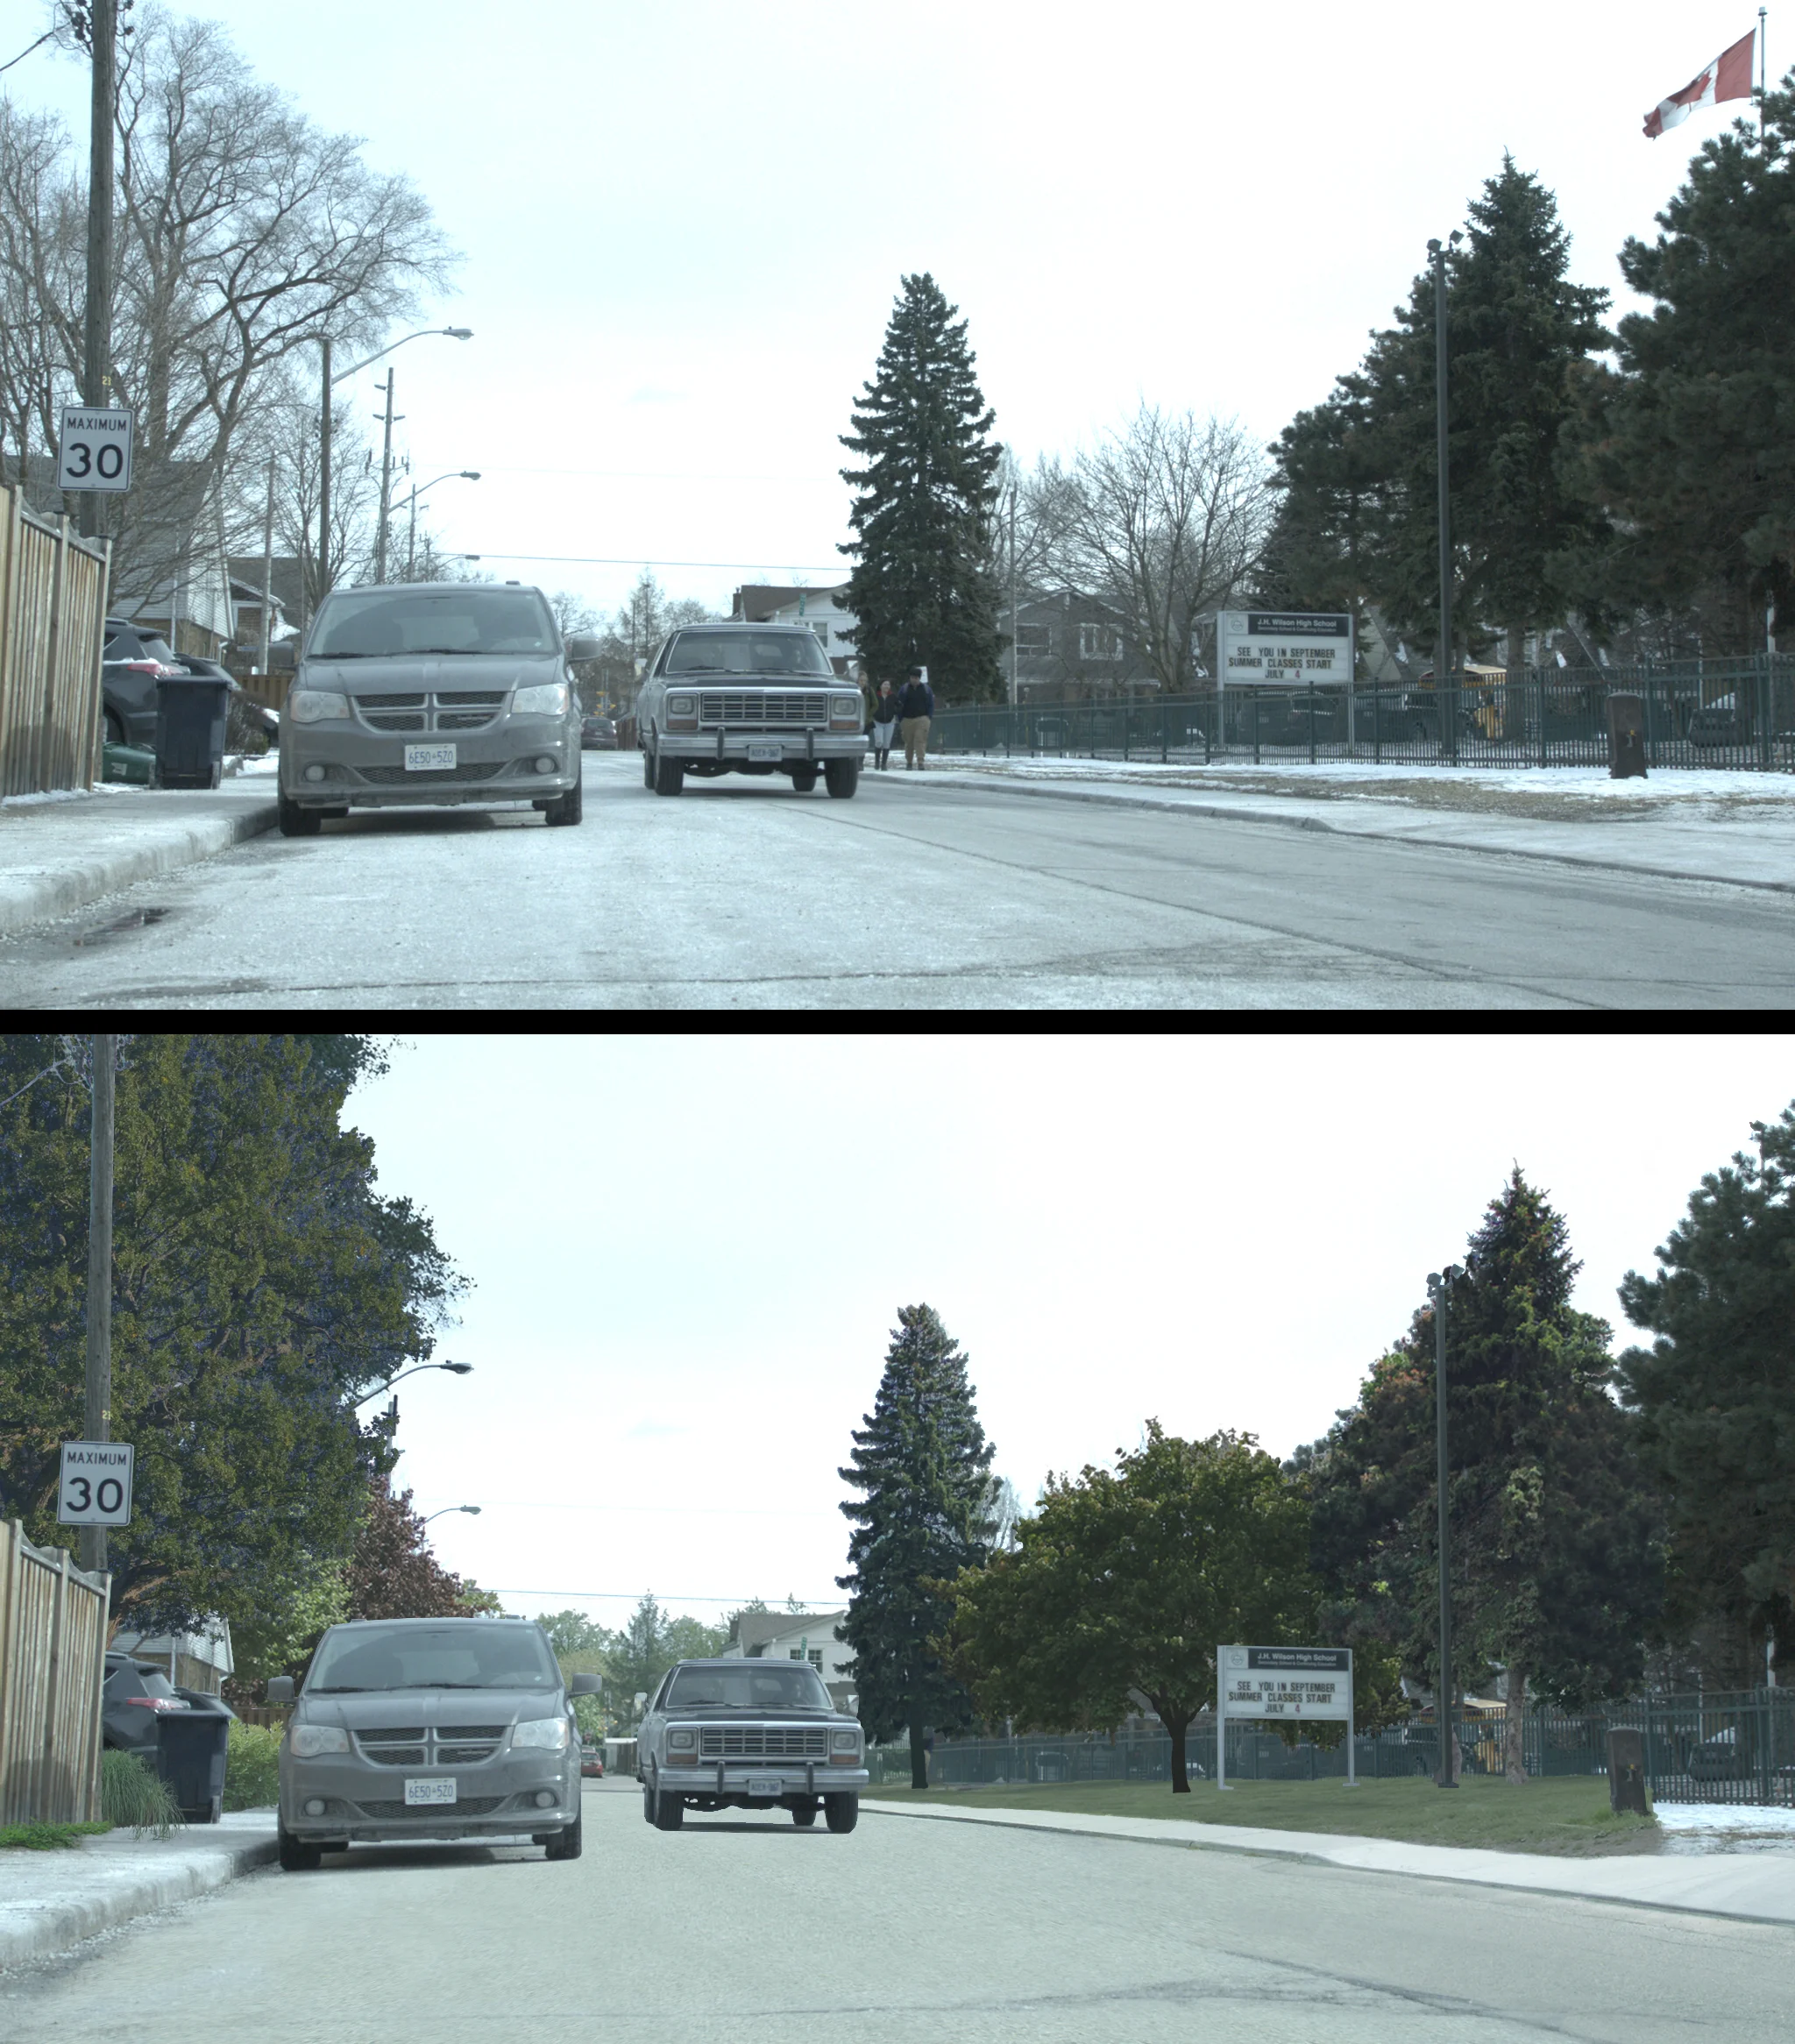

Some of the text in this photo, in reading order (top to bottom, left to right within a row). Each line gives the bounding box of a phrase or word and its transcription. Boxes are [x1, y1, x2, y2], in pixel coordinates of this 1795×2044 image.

[67, 417, 127, 431] MAXIMUM
[66, 442, 124, 479] 30
[1296, 619, 1312, 628] High
[1313, 619, 1337, 628] School
[1238, 647, 1336, 658] SEE YOU IN SEPTEMBER
[1229, 656, 1331, 669] SUMMER CLASSES START
[1265, 669, 1301, 678] JULY 4
[67, 1451, 127, 1466] MAXIMUM
[66, 1476, 124, 1514] 30
[1296, 1653, 1312, 1663] High
[1313, 1653, 1337, 1662] School
[1238, 1681, 1336, 1693] SEE YOU IN SEPTEMBER
[1229, 1691, 1331, 1703] SUMMER CLASSES START
[1265, 1703, 1301, 1713] JULY 4
